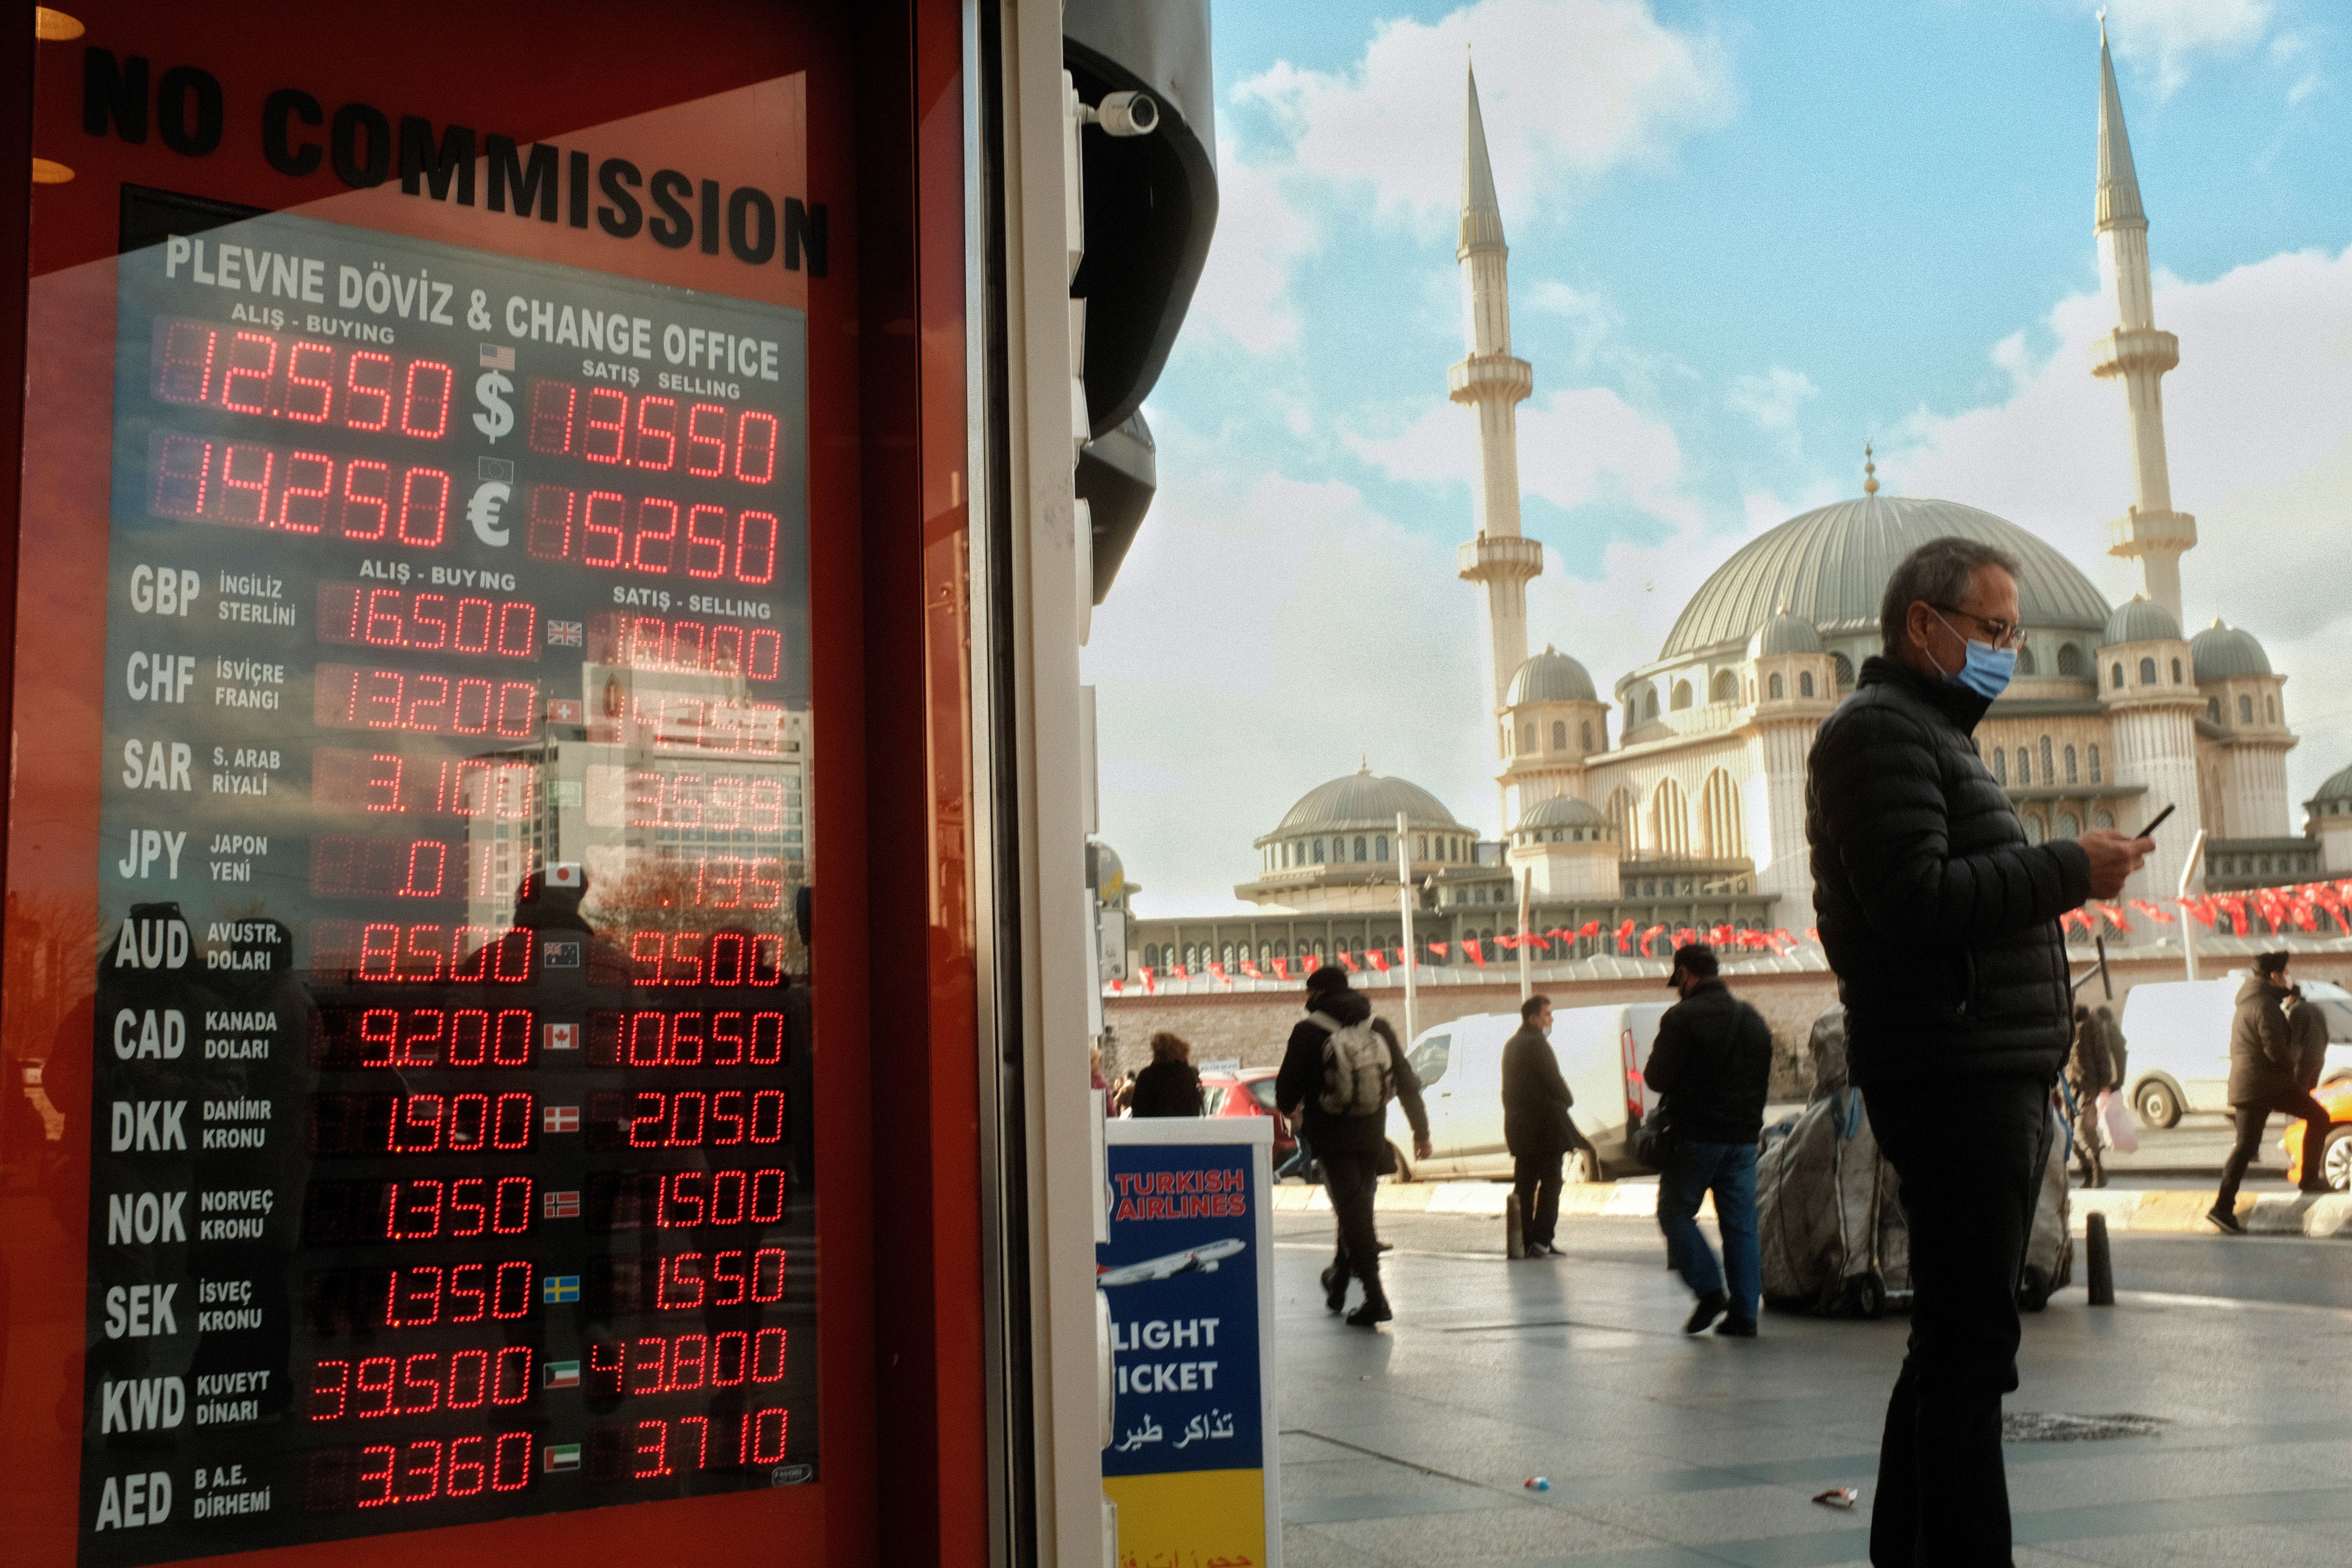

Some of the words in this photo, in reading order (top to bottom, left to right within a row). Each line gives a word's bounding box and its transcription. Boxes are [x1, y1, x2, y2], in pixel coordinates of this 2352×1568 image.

[82, 46, 223, 157] NO
[263, 88, 829, 278] COMMISSION
[166, 235, 325, 304] PLEVNE
[339, 262, 454, 325] DÖVİZ
[467, 289, 492, 332] &
[506, 295, 651, 360] CHANGE
[663, 324, 779, 382] OFFICE
[232, 303, 284, 330] ALIŞ
[307, 314, 395, 344] BUYING
[200, 331, 452, 439] 12.550
[583, 360, 640, 388] SATIŞ
[658, 372, 740, 399] SELLING
[564, 387, 778, 484] 13.550
[196, 443, 450, 547] 14.250
[563, 491, 778, 584] 15.250
[130, 564, 200, 616] GBP
[220, 570, 282, 599] İNGİLİZ
[360, 560, 410, 584] ALIŞ
[432, 566, 516, 591] BUYING
[218, 601, 296, 627] STERLİNİ
[351, 589, 535, 657] 16.500
[614, 586, 671, 612] SATIŞ
[689, 595, 770, 620] SELLING
[126, 651, 195, 704] CHF
[217, 655, 284, 686] İSVİÇRE
[215, 687, 278, 710] FRANGI
[349, 671, 535, 737] 13.200
[122, 739, 192, 791] SAR
[213, 747, 228, 766] S.
[234, 748, 280, 769] ARAB
[213, 770, 267, 796] RİYALİ
[367, 754, 533, 817] 3.100
[119, 829, 187, 879] JPY
[210, 834, 267, 855] JAPON
[210, 858, 250, 882] YENİ
[115, 919, 188, 969] AUD
[207, 922, 281, 943] AVUSTR.
[360, 923, 533, 982] 8.500
[207, 951, 271, 970] DOLARI
[632, 931, 783, 986] 9.500
[114, 1009, 186, 1060] CAD
[205, 1011, 277, 1031] KANADA
[361, 1009, 532, 1067] 9.200
[616, 1011, 783, 1066] 10.650
[205, 1039, 269, 1059] DOLARI
[111, 1100, 188, 1152] DKK
[203, 1096, 271, 1120] DANİMR
[388, 1093, 532, 1152] 1.900
[630, 1090, 785, 1148] 2.050
[203, 1128, 265, 1149] KRONU
[201, 1189, 274, 1214] NORVEÇ
[657, 1169, 785, 1227] 1.500
[1115, 1169, 1244, 1196] TURKISH
[1116, 1193, 1247, 1222] AIRLINES
[108, 1191, 187, 1245] NOK
[201, 1218, 264, 1240] KRONU
[386, 1176, 532, 1240] 1.350
[199, 1278, 252, 1305] İSVEÇ
[386, 1261, 532, 1328] 1.350
[657, 1248, 785, 1310] 1.550
[104, 1283, 179, 1339] SEK
[199, 1308, 262, 1332] KRONU
[1111, 1318, 1220, 1351] LIGHT
[197, 1370, 271, 1396] KUVEYT
[312, 1346, 532, 1421] 39.500
[591, 1327, 787, 1395] 43.800
[1115, 1361, 1218, 1395] ICKET
[102, 1376, 186, 1434] KWD
[197, 1399, 258, 1425] DİNARI
[1173, 1408, 1234, 1449] تذاكر
[635, 1408, 788, 1479] 3.710
[358, 1432, 532, 1508] 3.360
[95, 1471, 172, 1532] AED
[194, 1485, 270, 1519] DİRHEMİ
